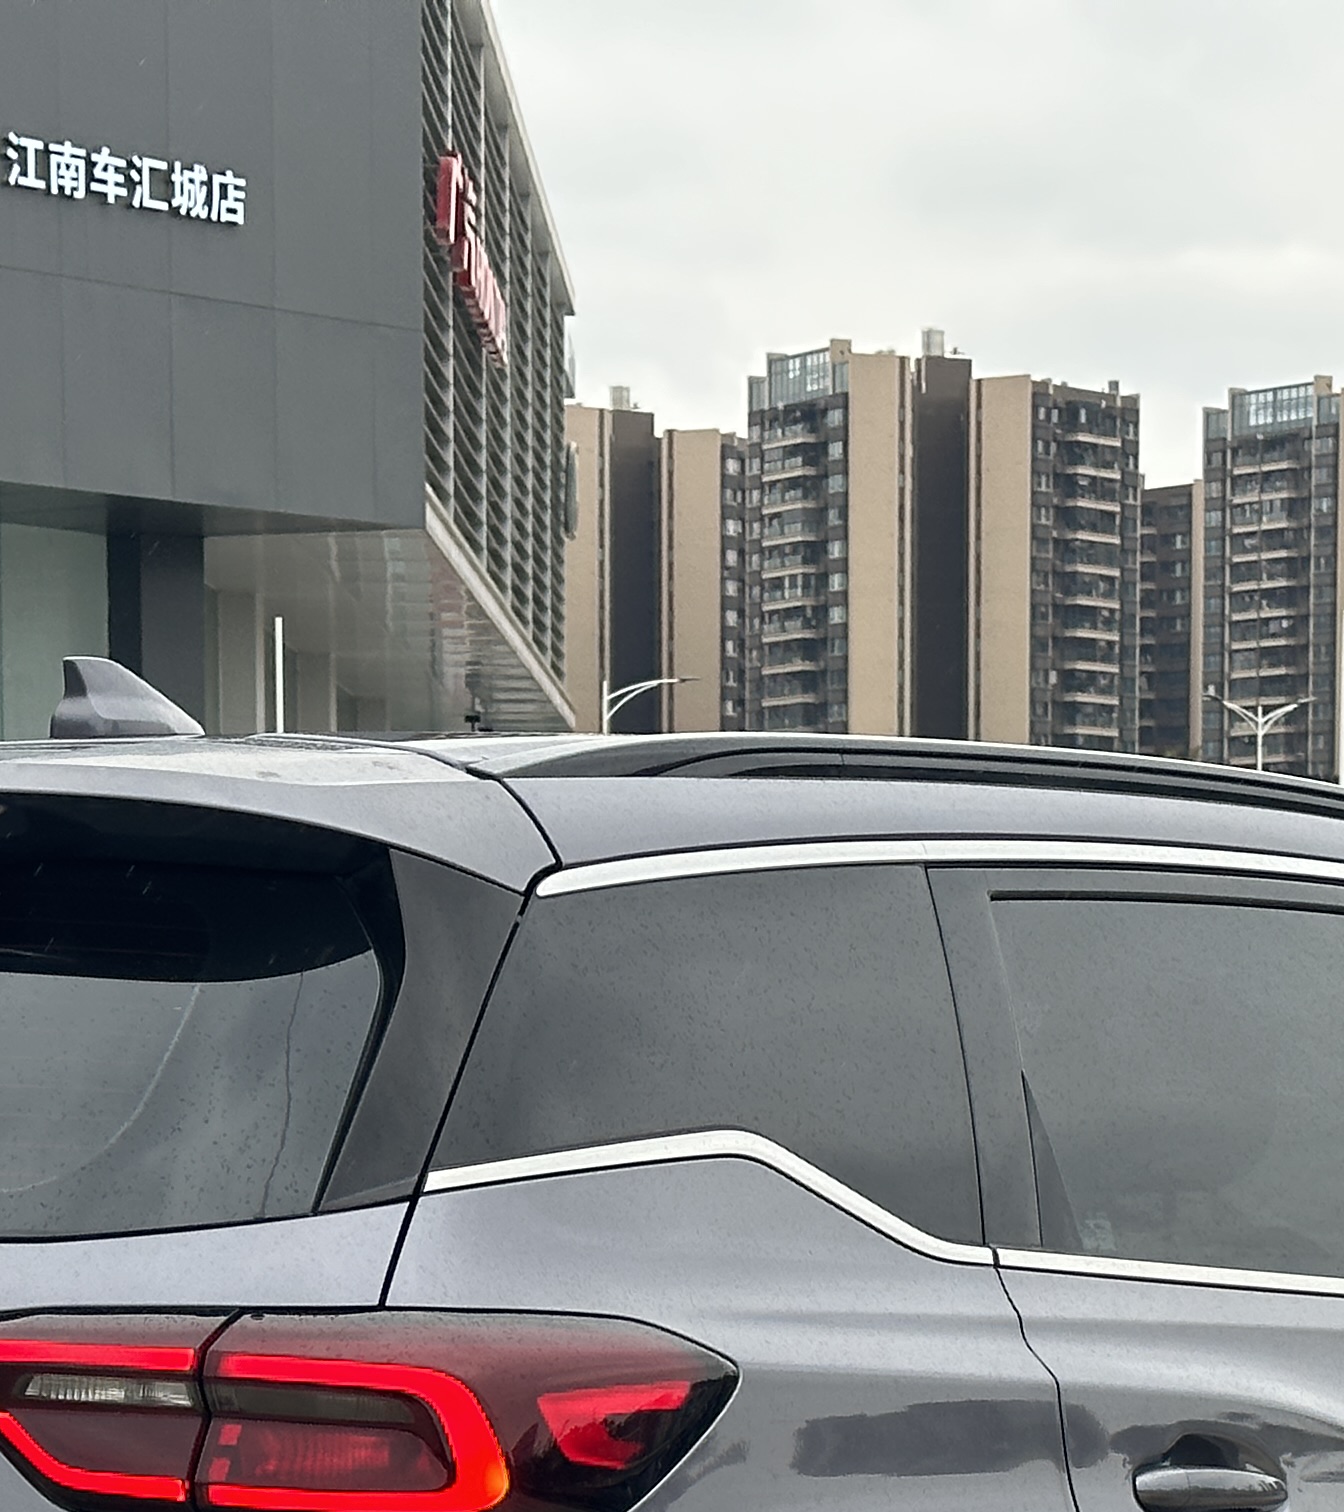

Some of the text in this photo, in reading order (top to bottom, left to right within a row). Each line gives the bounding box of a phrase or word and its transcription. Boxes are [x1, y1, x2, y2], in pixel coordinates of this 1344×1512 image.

[6, 131, 247, 225] 江南车汇城店
